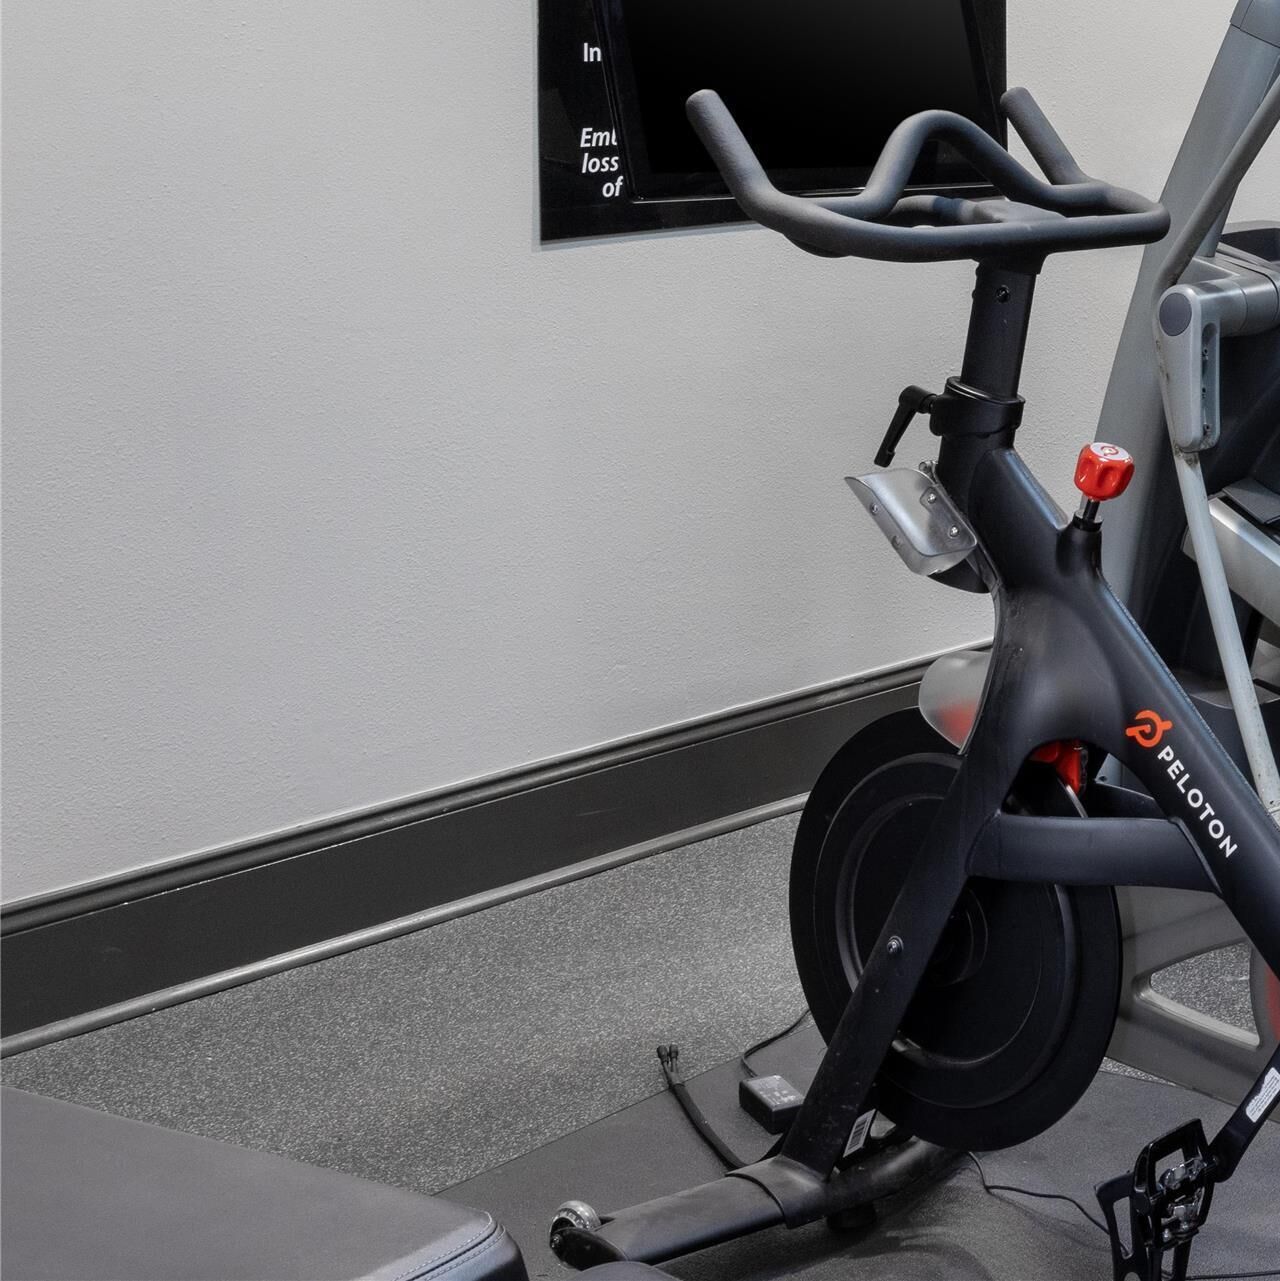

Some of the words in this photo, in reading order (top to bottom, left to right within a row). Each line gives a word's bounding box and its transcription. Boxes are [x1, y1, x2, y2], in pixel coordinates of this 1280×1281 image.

[581, 152, 620, 174] loss
[601, 175, 624, 198] of
[1157, 745, 1238, 858] PELOTON
